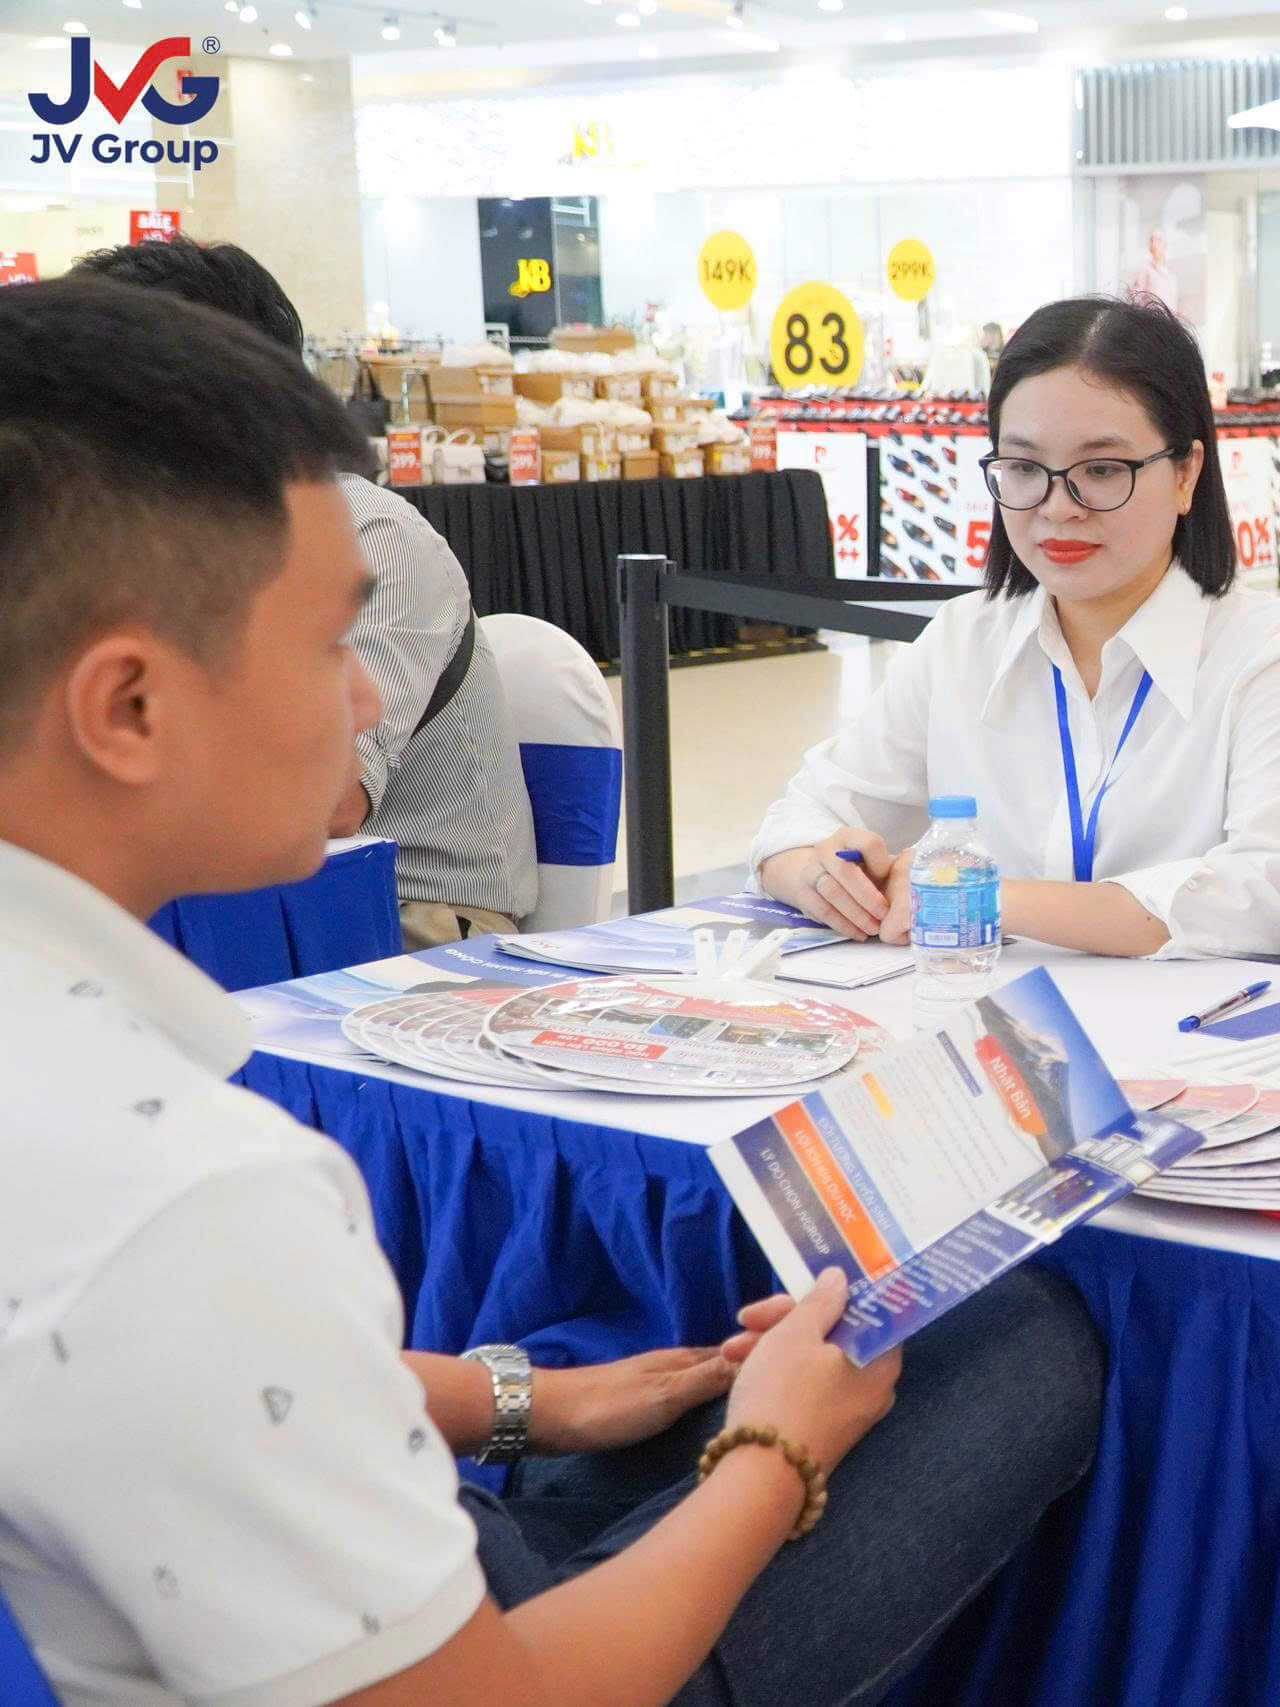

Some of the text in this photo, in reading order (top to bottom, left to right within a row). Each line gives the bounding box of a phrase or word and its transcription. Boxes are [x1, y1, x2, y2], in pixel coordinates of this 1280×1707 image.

[703, 258, 752, 282] 149K
[784, 312, 850, 376] 83
[1236, 517, 1270, 567] 0%
